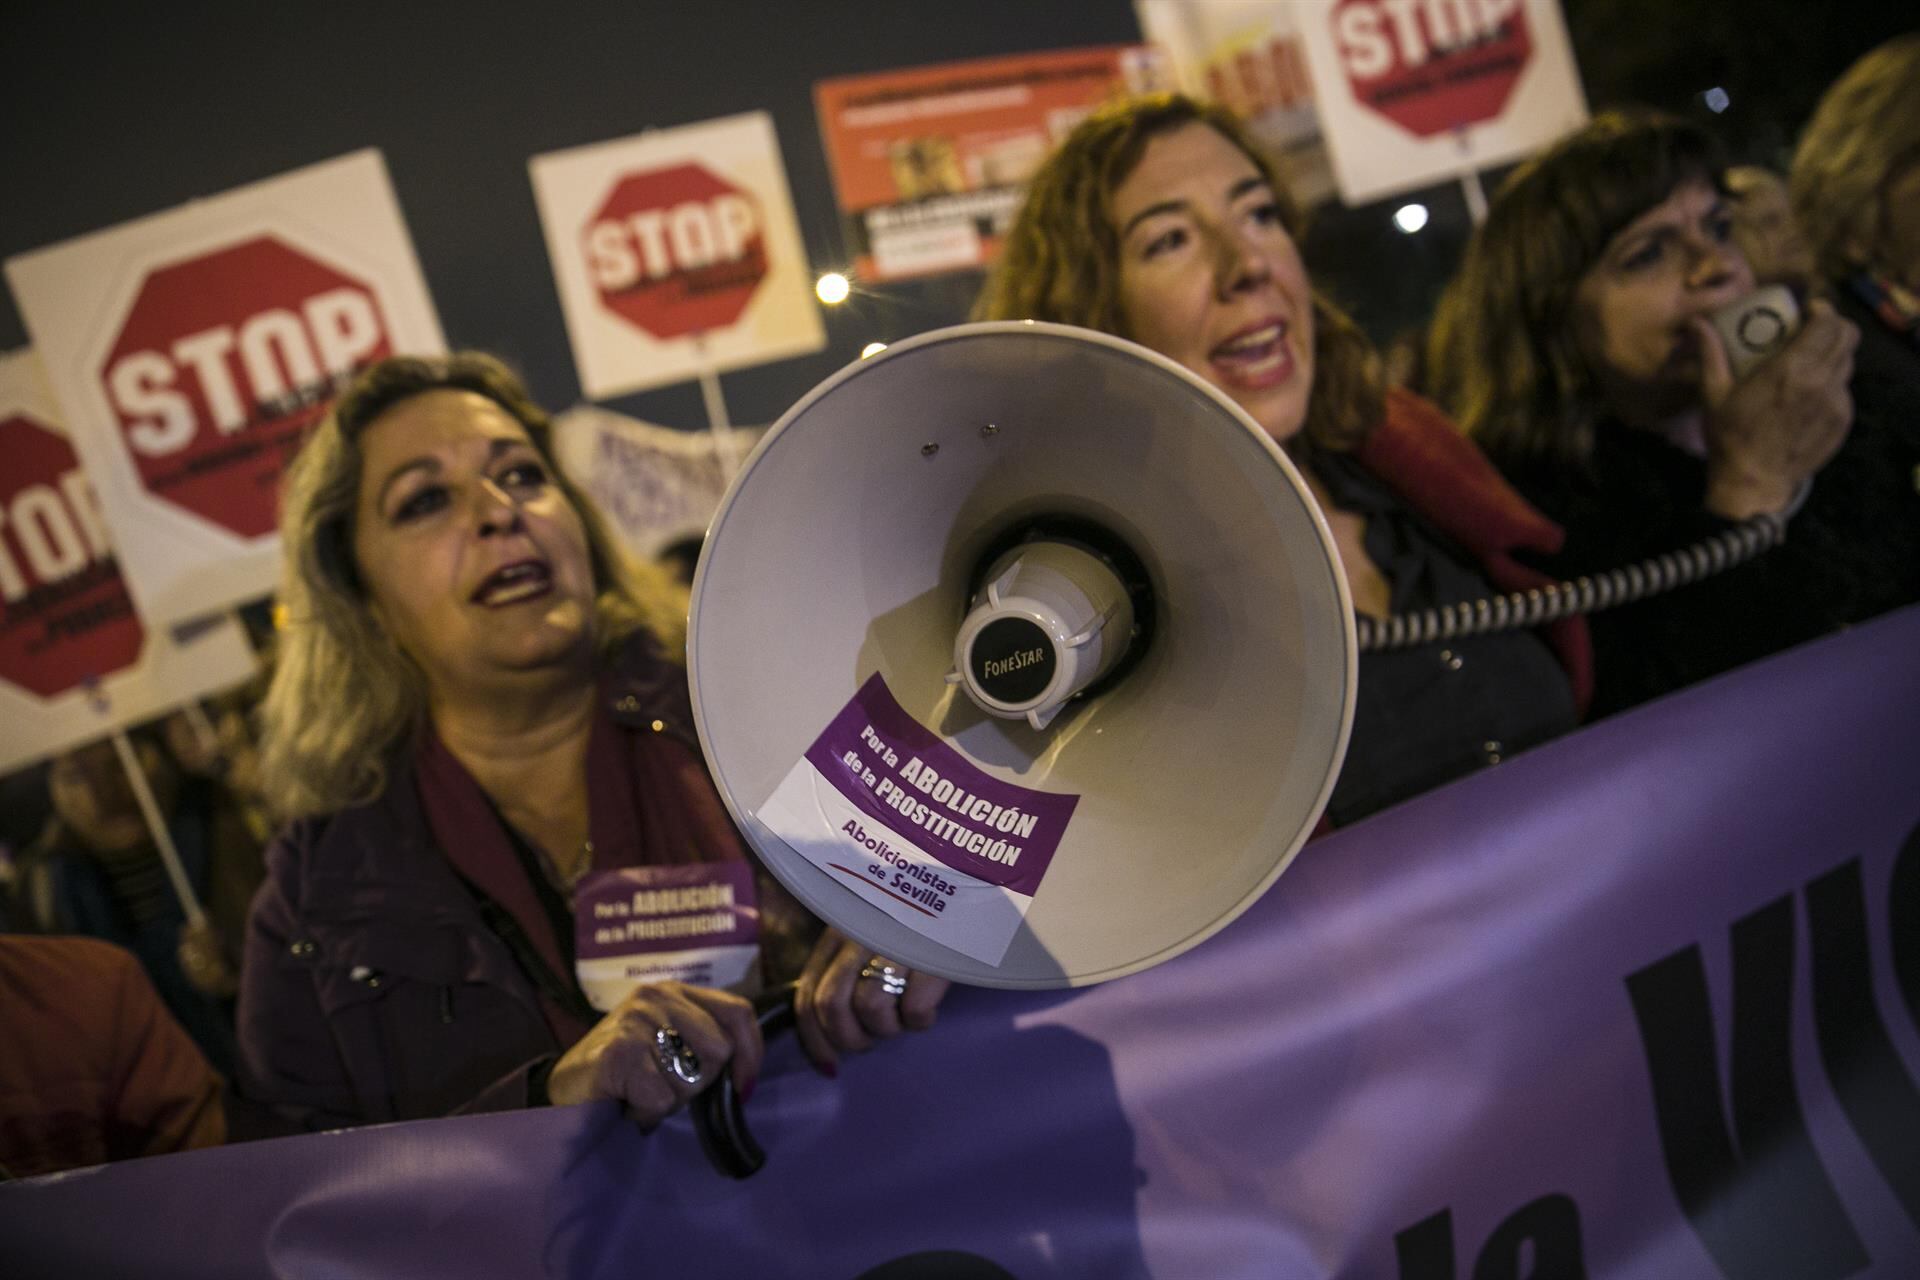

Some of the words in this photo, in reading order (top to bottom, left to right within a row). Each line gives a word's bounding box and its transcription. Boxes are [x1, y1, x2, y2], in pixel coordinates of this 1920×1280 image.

[591, 194, 753, 290] STOP
[111, 289, 380, 456] STOP
[843, 750, 864, 773] de
[860, 766, 877, 788] la
[875, 777, 1022, 867] PROSTITUCIÓN
[860, 724, 886, 754] Por
[881, 748, 899, 768] la
[899, 756, 1039, 839] ABOLICIÓN
[842, 820, 957, 896] Abolicionistas
[868, 863, 887, 880] de
[890, 875, 946, 912] Sevilla
[1623, 820, 1920, 1280] VI
